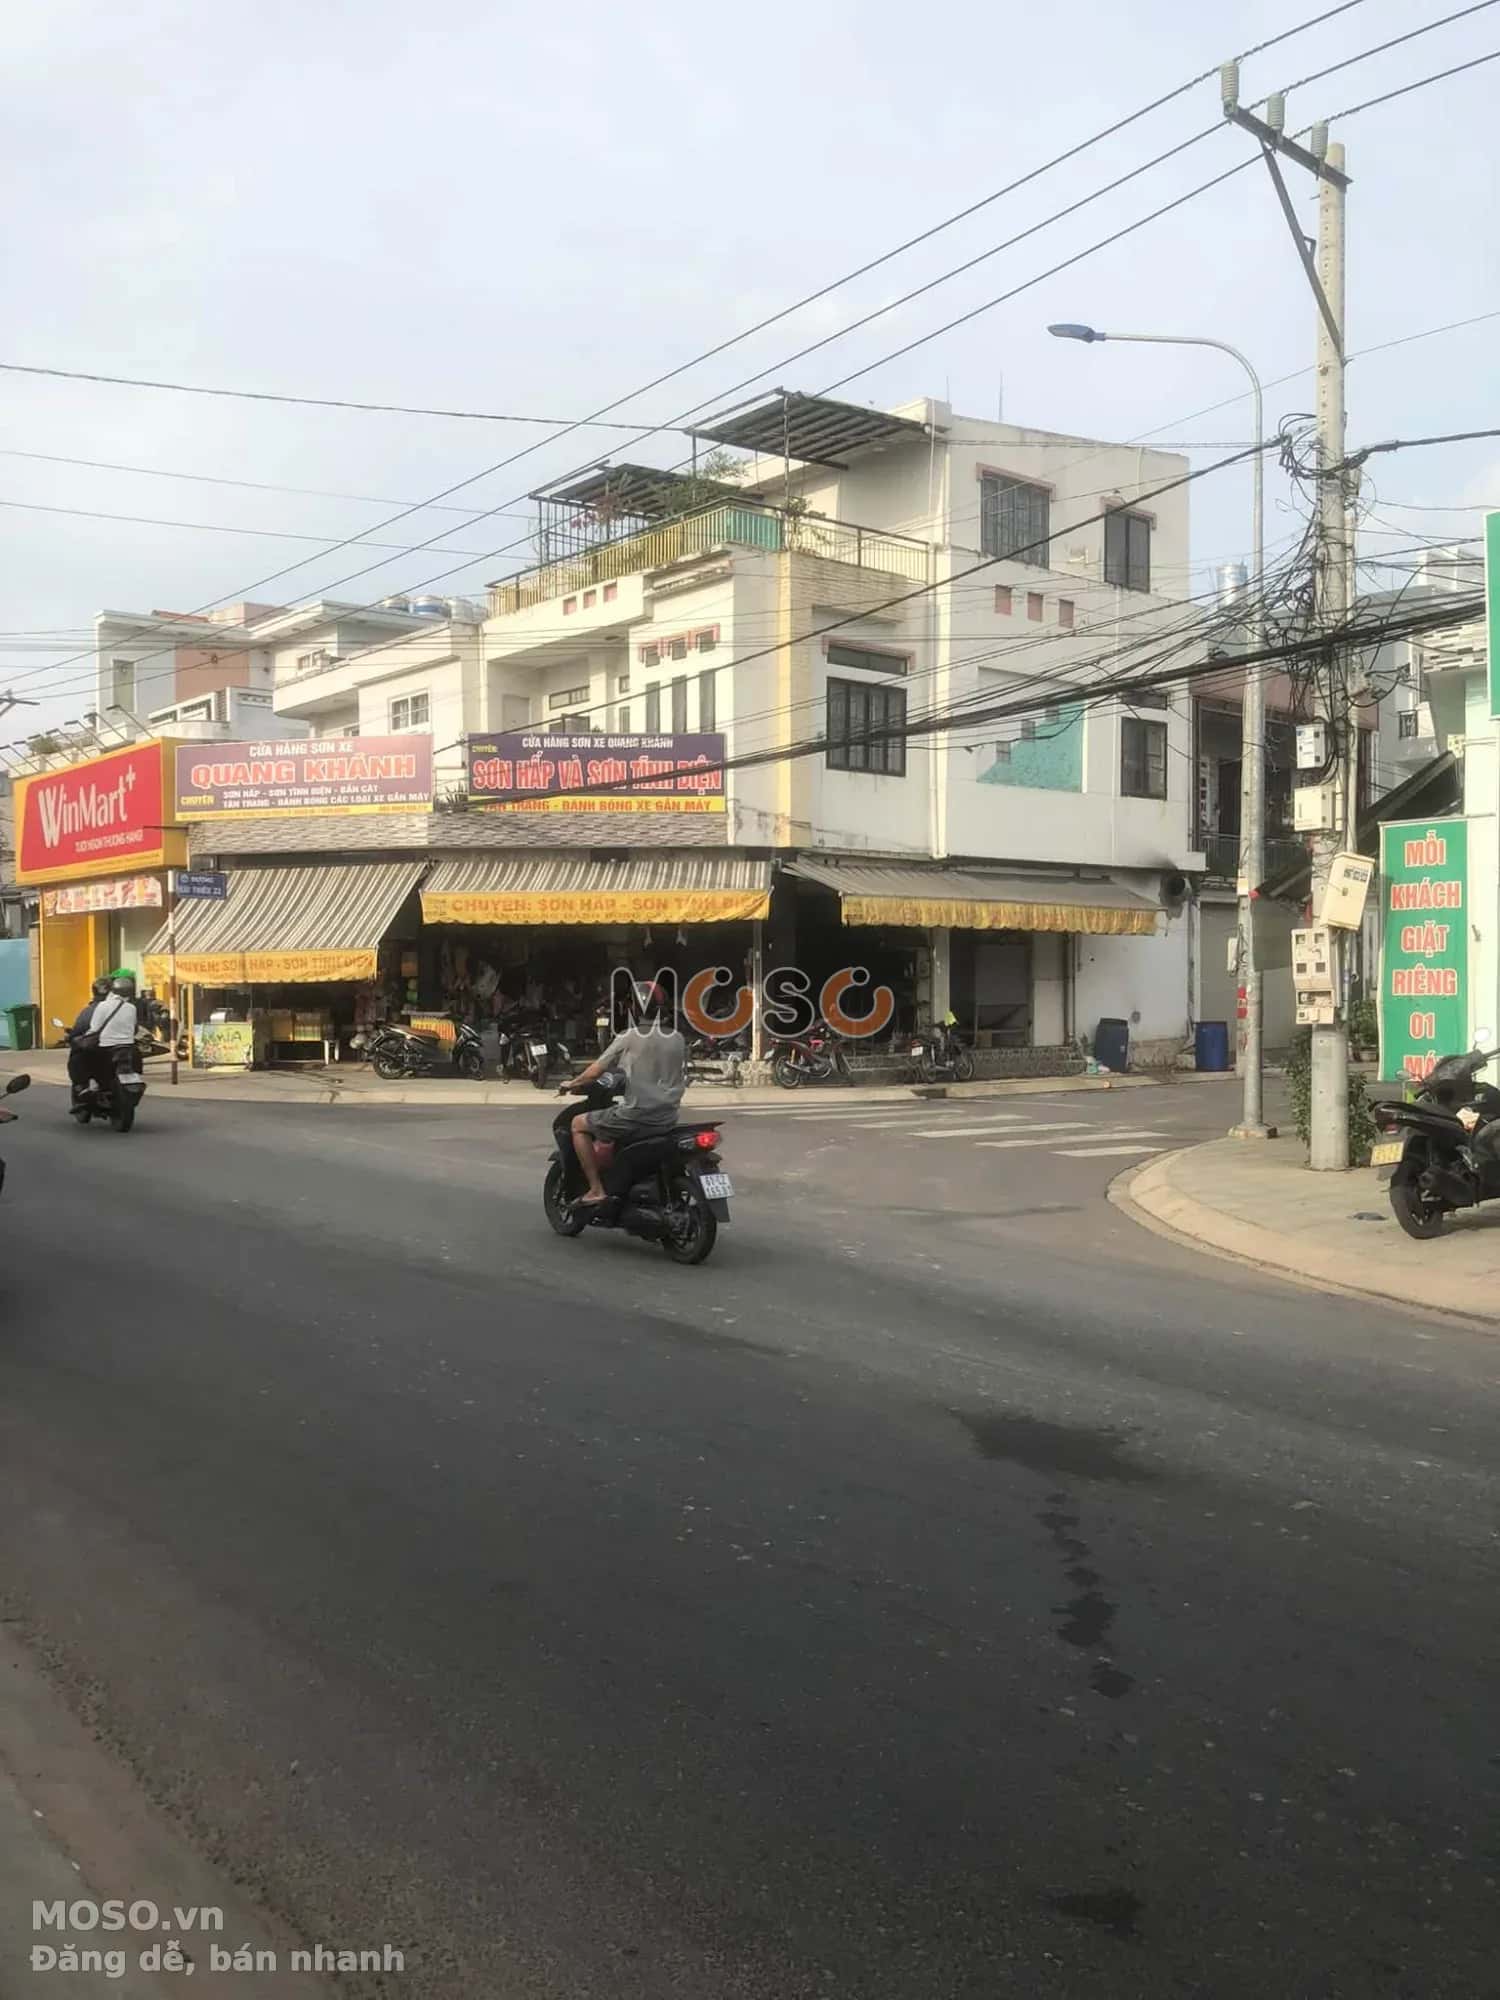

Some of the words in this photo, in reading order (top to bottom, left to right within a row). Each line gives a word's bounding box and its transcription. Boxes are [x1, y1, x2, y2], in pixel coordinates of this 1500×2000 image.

[249, 741, 273, 757] CỬA
[275, 741, 308, 755] HÀNG
[311, 742, 336, 754] SƠN
[339, 741, 353, 752] XE
[521, 734, 541, 748] CỬA
[544, 736, 569, 748] HÀNG
[571, 736, 591, 748] SƠN
[594, 738, 605, 748] XE
[608, 738, 639, 749] QUANG
[191, 760, 296, 790] QUANG
[304, 752, 416, 783] KHÁNH
[473, 757, 512, 789] SƠN
[558, 754, 584, 789] VÀ
[587, 757, 627, 789] SƠN
[630, 755, 673, 789] TĨNH
[677, 754, 722, 795] ĐIỆN
[637, 799, 650, 811] XE
[1404, 831, 1446, 868] MỖI
[1391, 877, 1461, 911] KHÁCH
[1401, 920, 1449, 958] GIẶT
[1392, 963, 1457, 996] RIÊNG
[1410, 1011, 1436, 1040] 01
